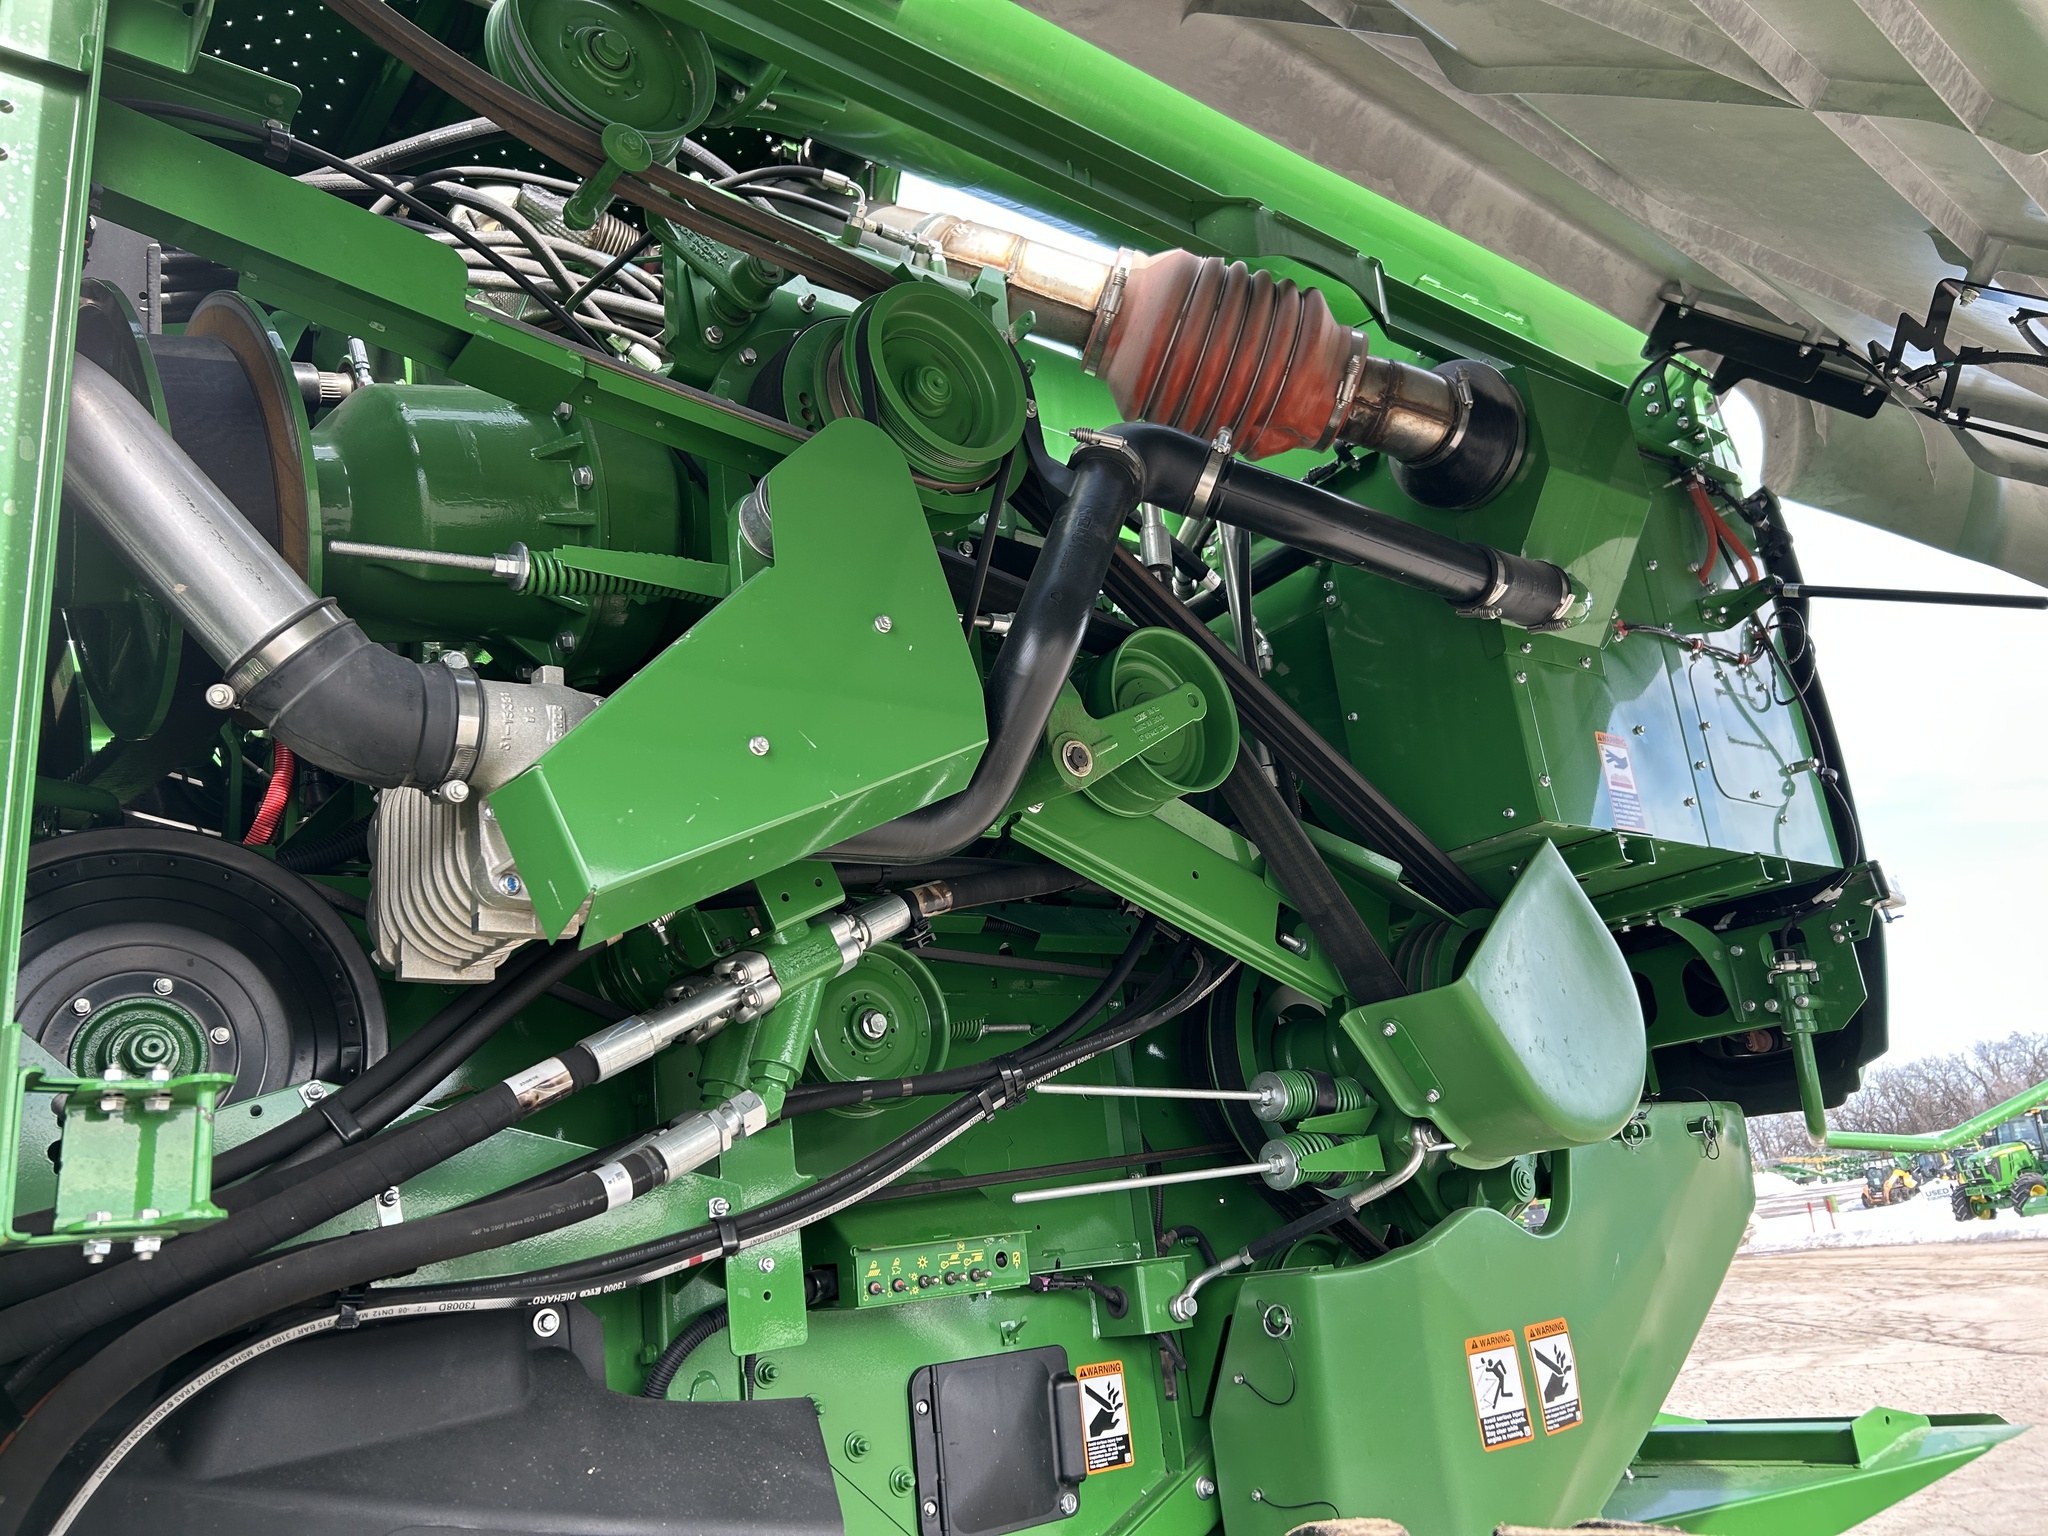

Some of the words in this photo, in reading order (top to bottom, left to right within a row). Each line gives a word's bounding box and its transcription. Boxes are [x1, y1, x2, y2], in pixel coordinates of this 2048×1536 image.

[1925, 1188, 1949, 1198] USED
[602, 1280, 627, 1293] T3000
[438, 1300, 476, 1311] T3008D
[372, 1308, 393, 1317] DN12
[296, 1324, 316, 1335] BAR
[317, 1319, 332, 1329] 215
[1535, 1321, 1565, 1336] WARNING
[271, 1332, 290, 1345] 3100
[1479, 1334, 1511, 1348] WARNING
[255, 1340, 271, 1352] PSI
[229, 1349, 254, 1366] MSHA
[196, 1361, 229, 1386] IC-227/12
[1086, 1362, 1121, 1377] WARNING
[172, 1384, 196, 1403] FRAS
[128, 1405, 168, 1442] ABRASION
[94, 1439, 132, 1480] RESISTANT
